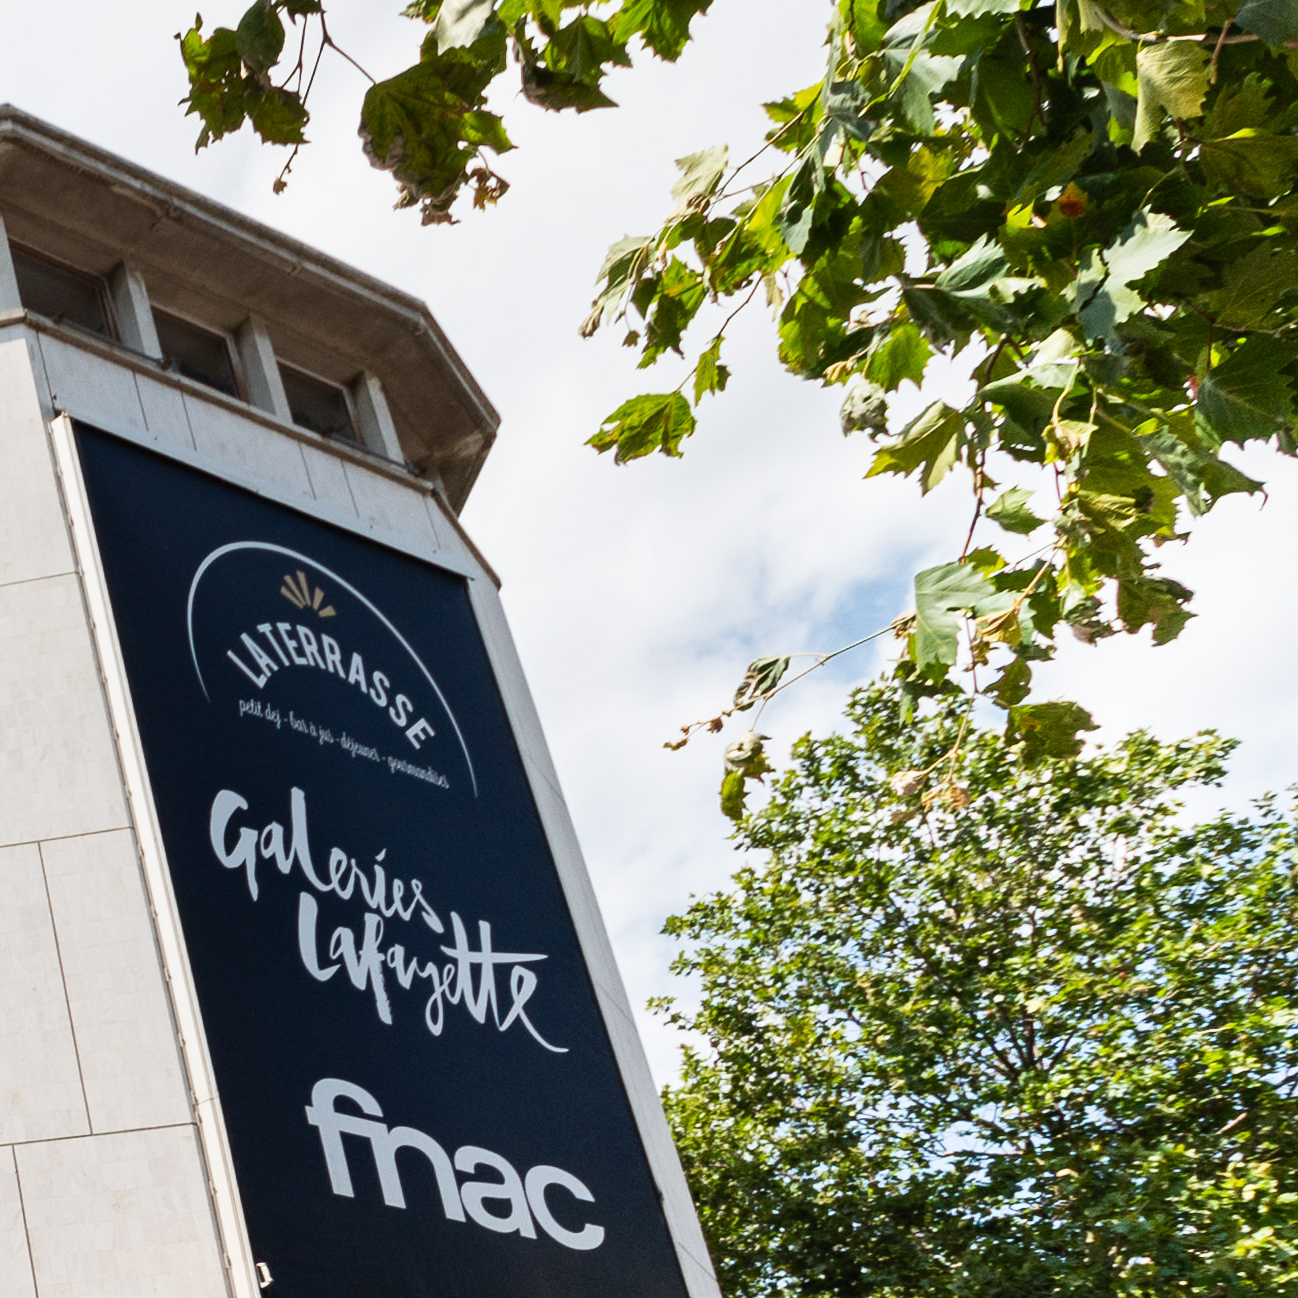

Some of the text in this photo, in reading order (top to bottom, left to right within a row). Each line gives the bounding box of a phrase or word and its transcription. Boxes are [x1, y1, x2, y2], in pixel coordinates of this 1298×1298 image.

[209, 787, 445, 934] Galeries
[297, 892, 569, 1053] Lafayette
[305, 1077, 605, 1251] fnac
